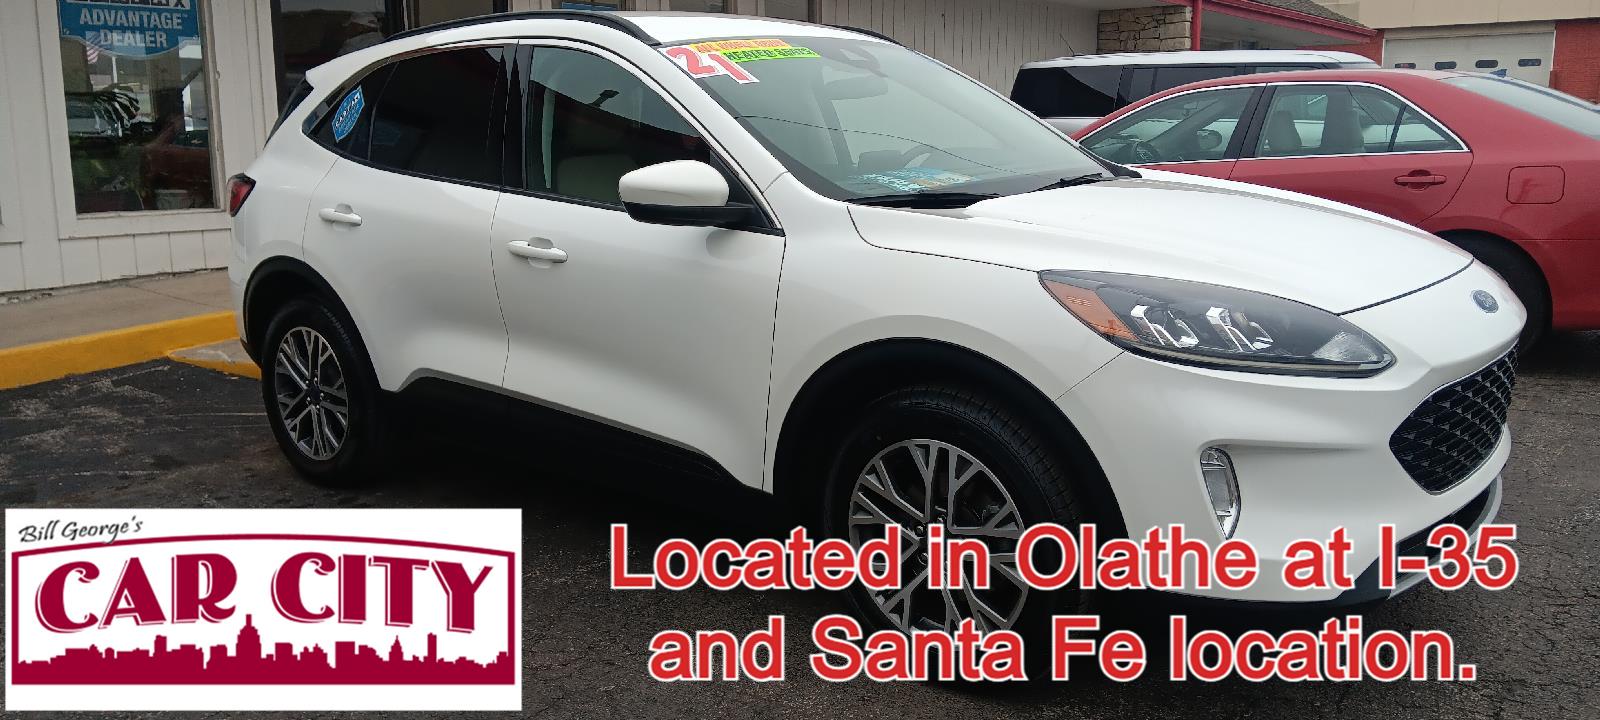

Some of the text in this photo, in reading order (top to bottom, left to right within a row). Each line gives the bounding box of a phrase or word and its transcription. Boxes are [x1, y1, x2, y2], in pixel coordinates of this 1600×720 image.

[80, 8, 183, 29] ADVANTAGE
[100, 29, 168, 48] DEALER
[665, 47, 753, 81] 21
